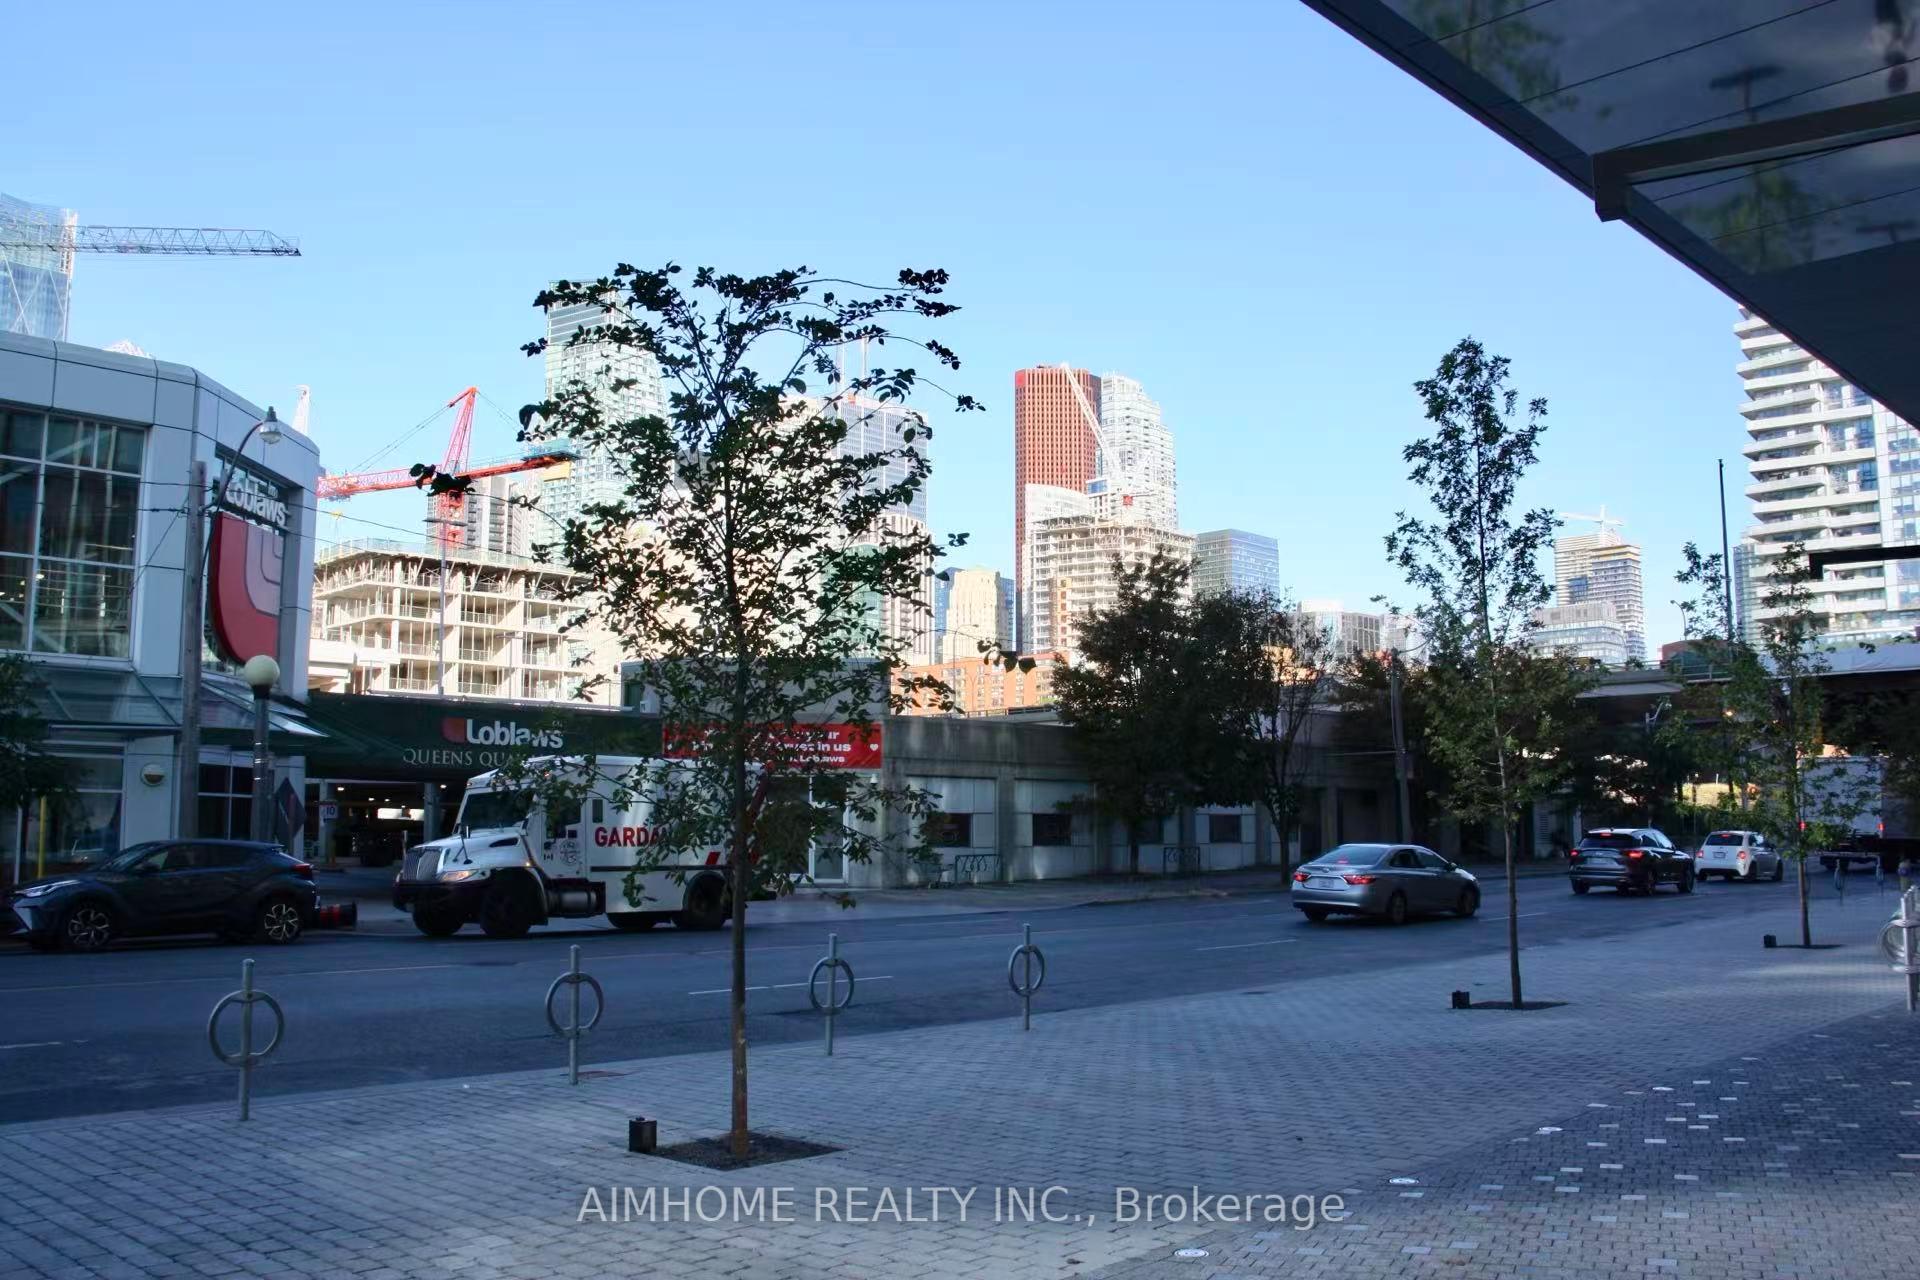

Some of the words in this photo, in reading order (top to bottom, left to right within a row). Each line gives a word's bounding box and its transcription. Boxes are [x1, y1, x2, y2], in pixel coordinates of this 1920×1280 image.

[466, 719, 564, 748] Loblaws
[817, 740, 831, 752] in
[833, 743, 852, 752] us
[402, 748, 473, 766] QUEENS
